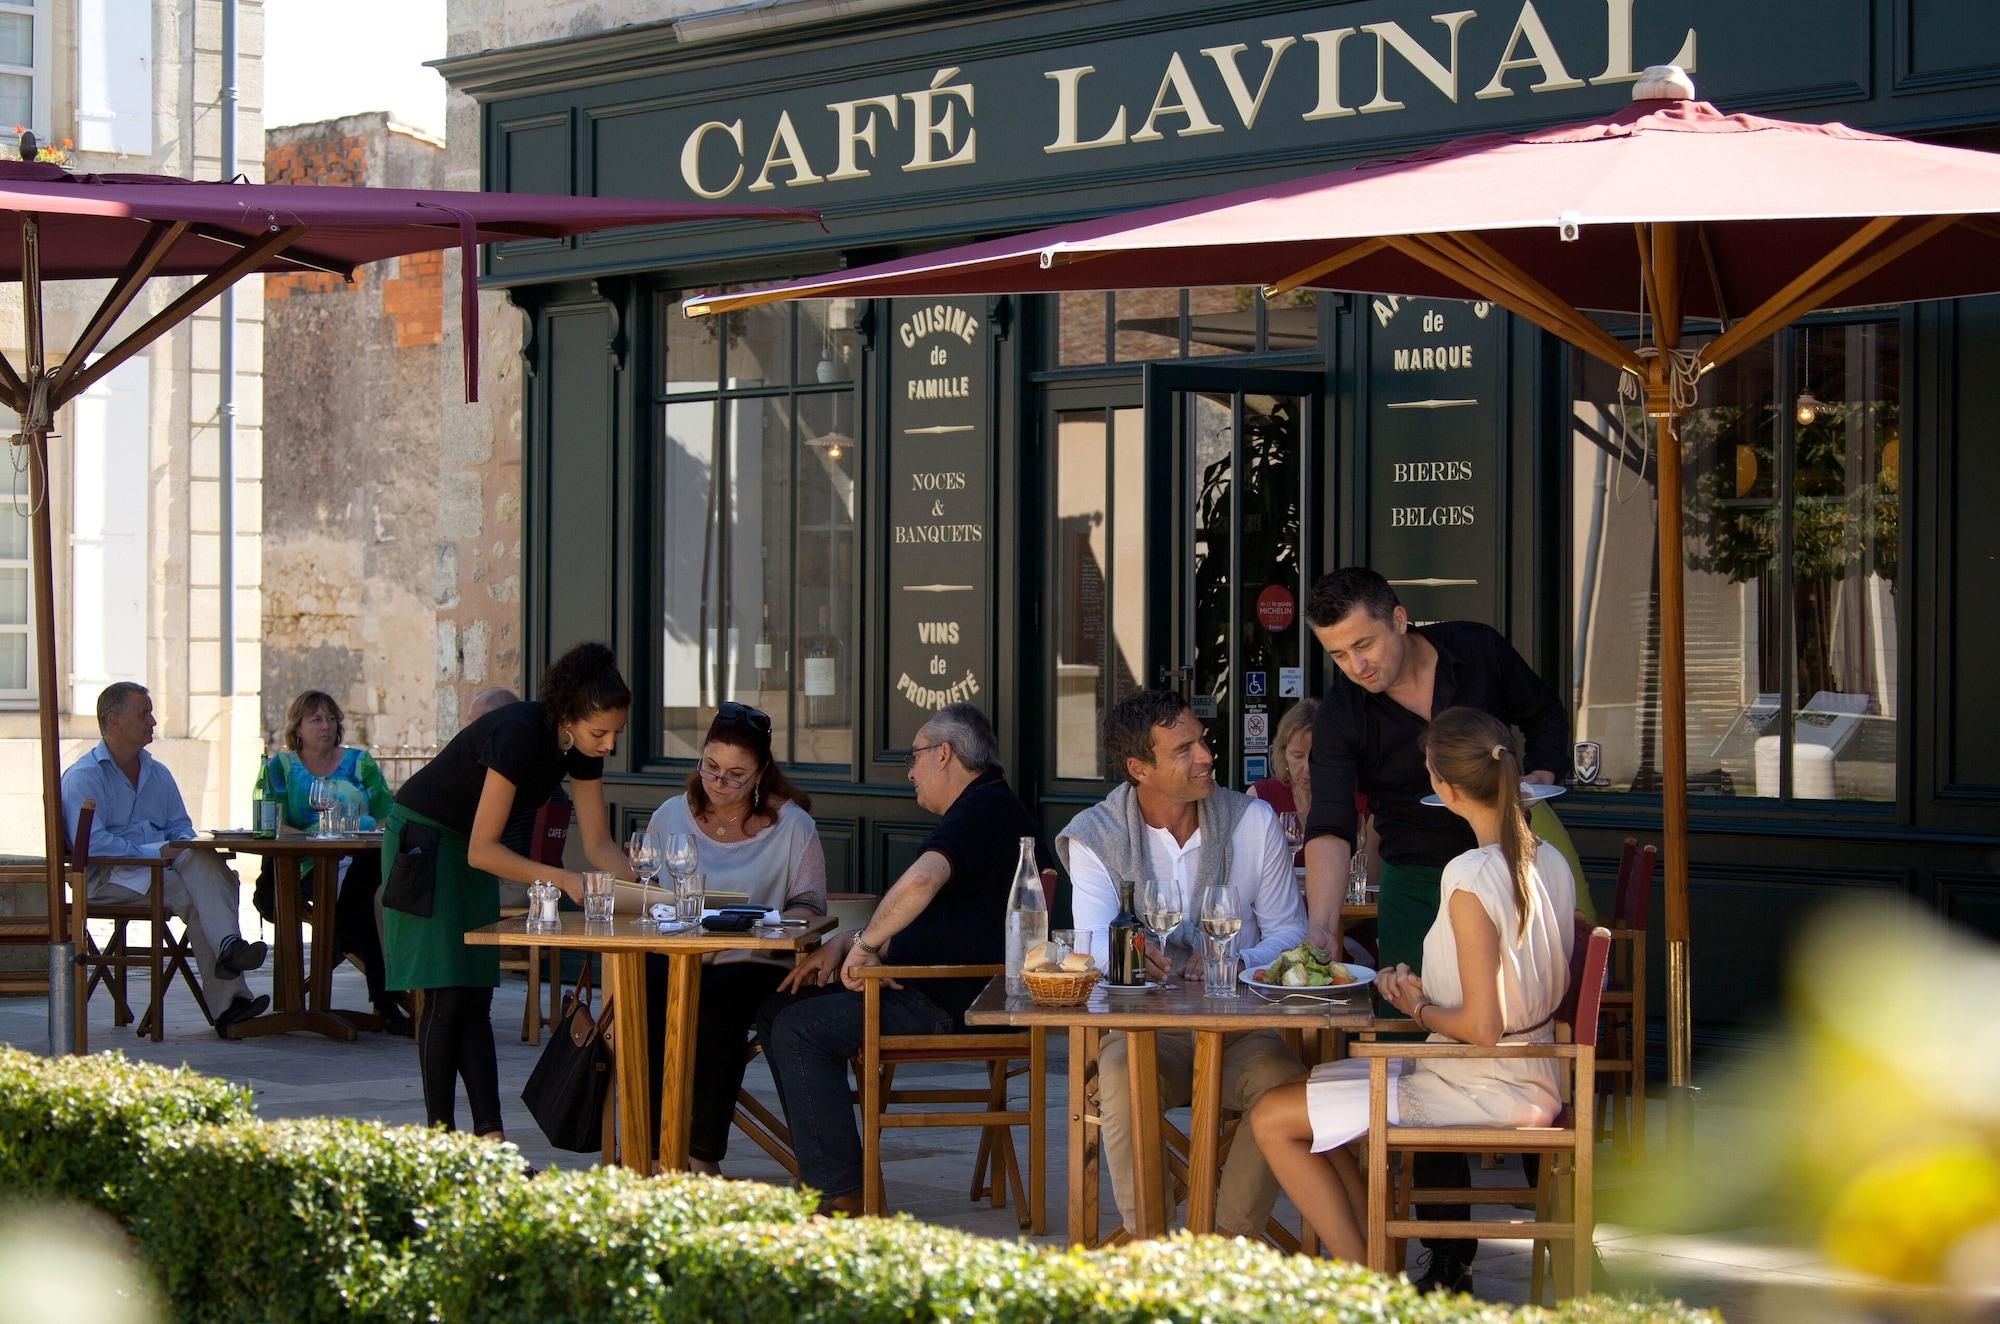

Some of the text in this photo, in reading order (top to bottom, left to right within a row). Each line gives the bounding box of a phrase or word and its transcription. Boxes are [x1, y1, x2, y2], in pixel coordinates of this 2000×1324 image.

[680, 0, 1697, 199] CAFÉ LAVINAL
[900, 304, 979, 348] CUISINE
[1422, 309, 1444, 333] de
[930, 345, 947, 366] de
[1394, 345, 1473, 372] MARQUE
[908, 376, 970, 400] FAMILLE
[911, 472, 966, 491] NOCES
[1393, 460, 1473, 483] BIERES
[931, 499, 945, 517] &
[1391, 505, 1475, 527] BELGES
[895, 524, 983, 544] BANQUETS
[1259, 607, 1292, 615] MICHELIN
[918, 621, 960, 645] VINS
[930, 654, 947, 675] de
[896, 669, 980, 711] PROPRIÉTÉ
